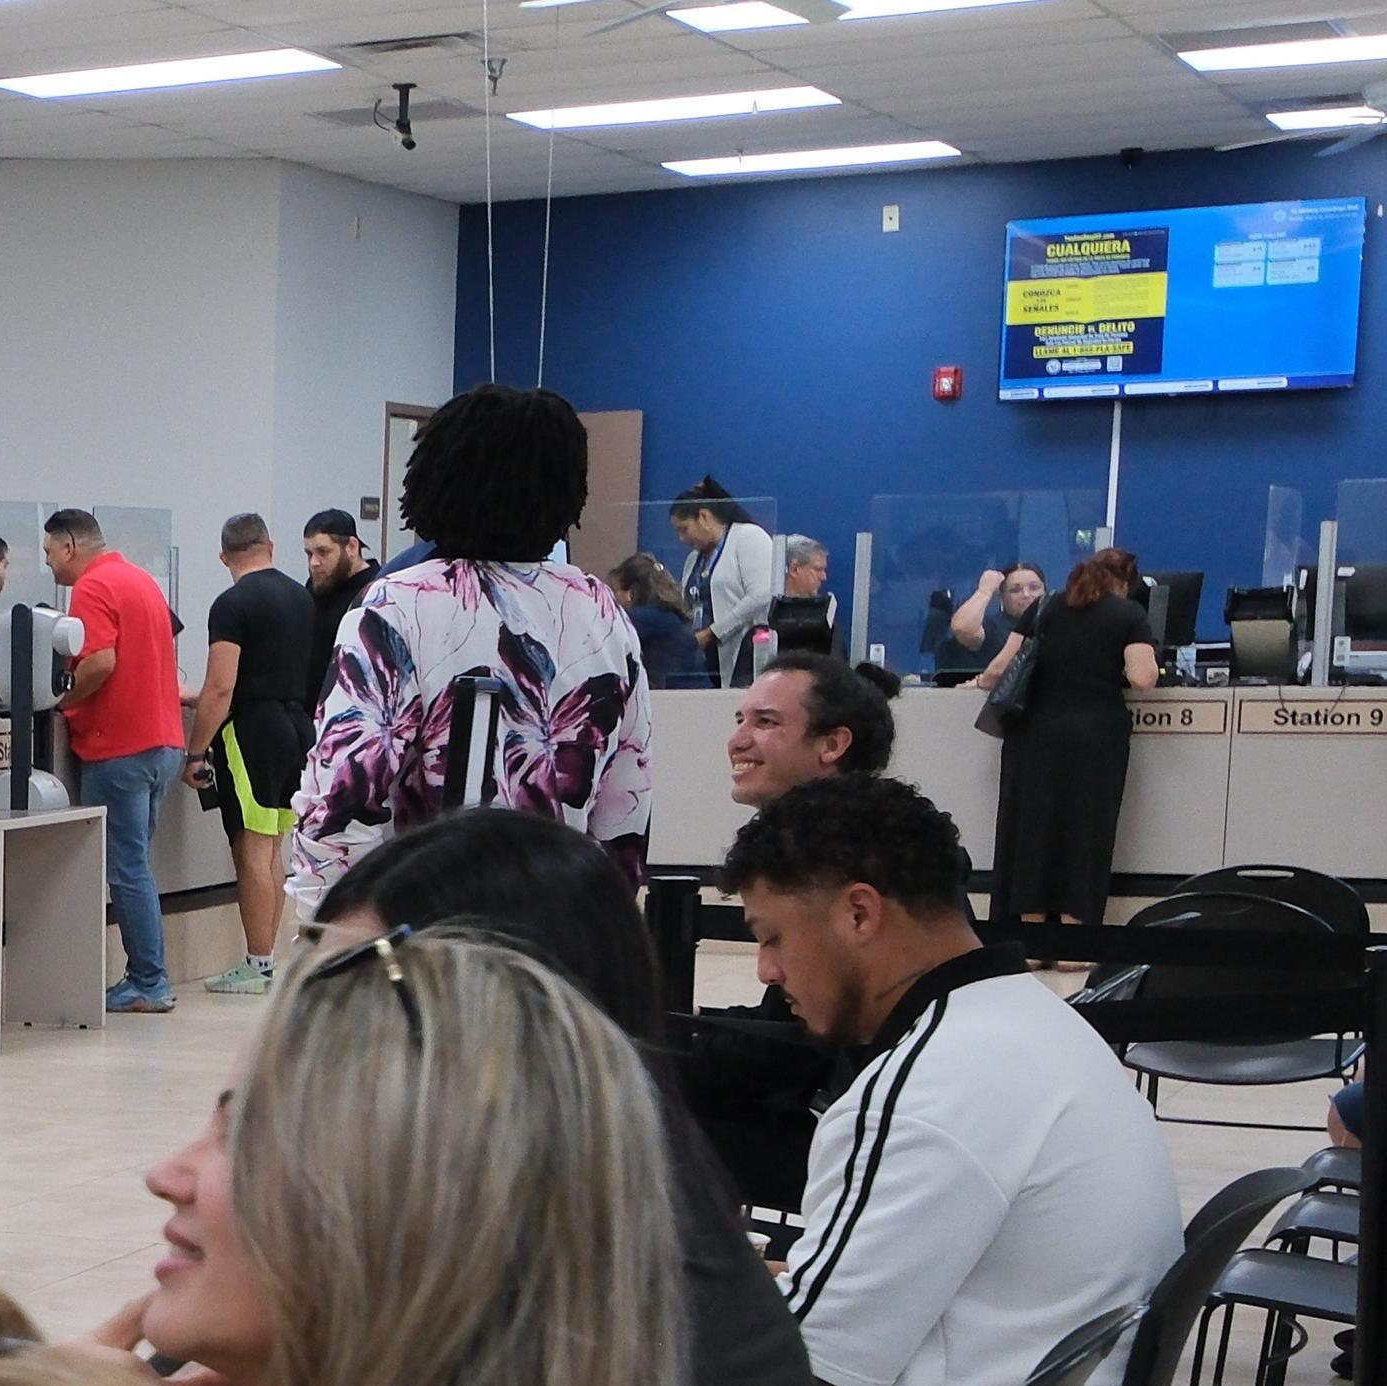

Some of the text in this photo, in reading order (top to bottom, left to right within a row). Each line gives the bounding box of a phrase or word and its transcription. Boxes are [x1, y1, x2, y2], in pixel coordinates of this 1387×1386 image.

[1046, 239, 1131, 257] CUALQUIERA
[1180, 708, 1193, 726] 8
[1273, 708, 1383, 726] Station 9
